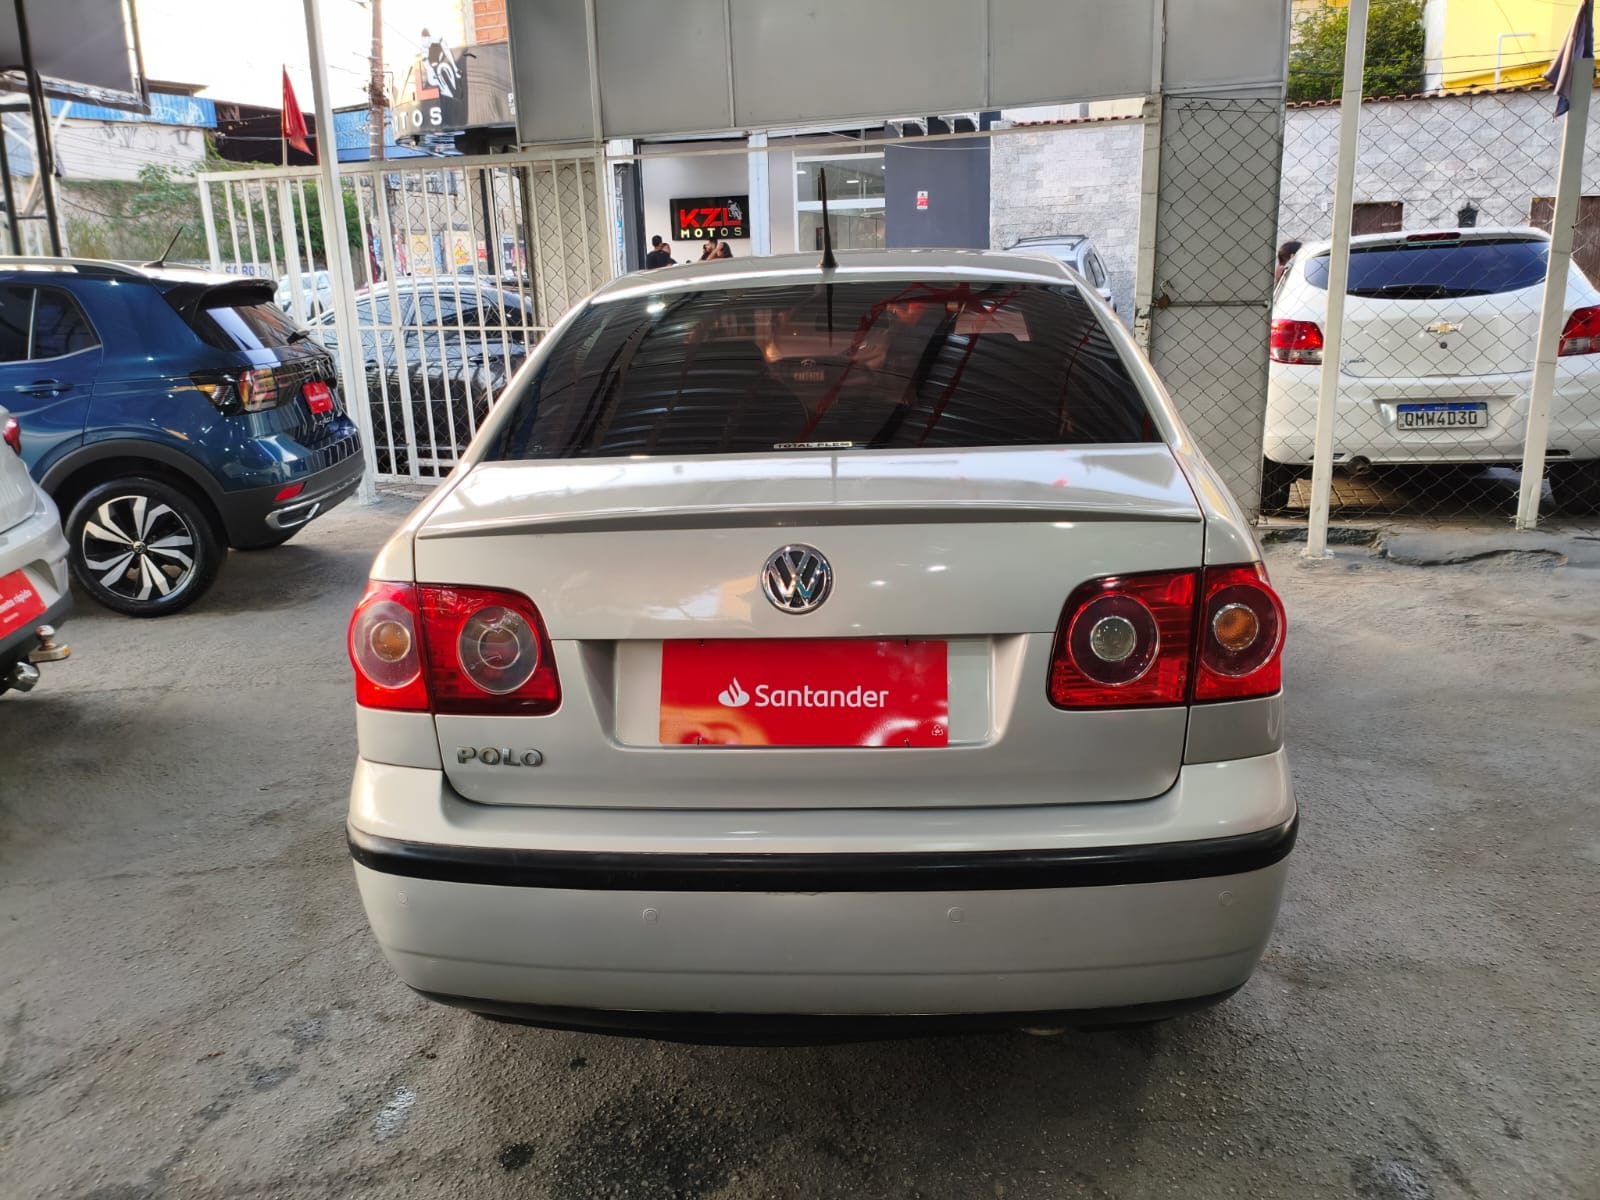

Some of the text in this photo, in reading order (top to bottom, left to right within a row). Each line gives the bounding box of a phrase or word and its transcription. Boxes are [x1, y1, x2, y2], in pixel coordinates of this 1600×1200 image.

[680, 207, 743, 229] KZL
[681, 226, 743, 238] MOTOS
[754, 684, 889, 708] Santander
[457, 746, 543, 767] POLO
